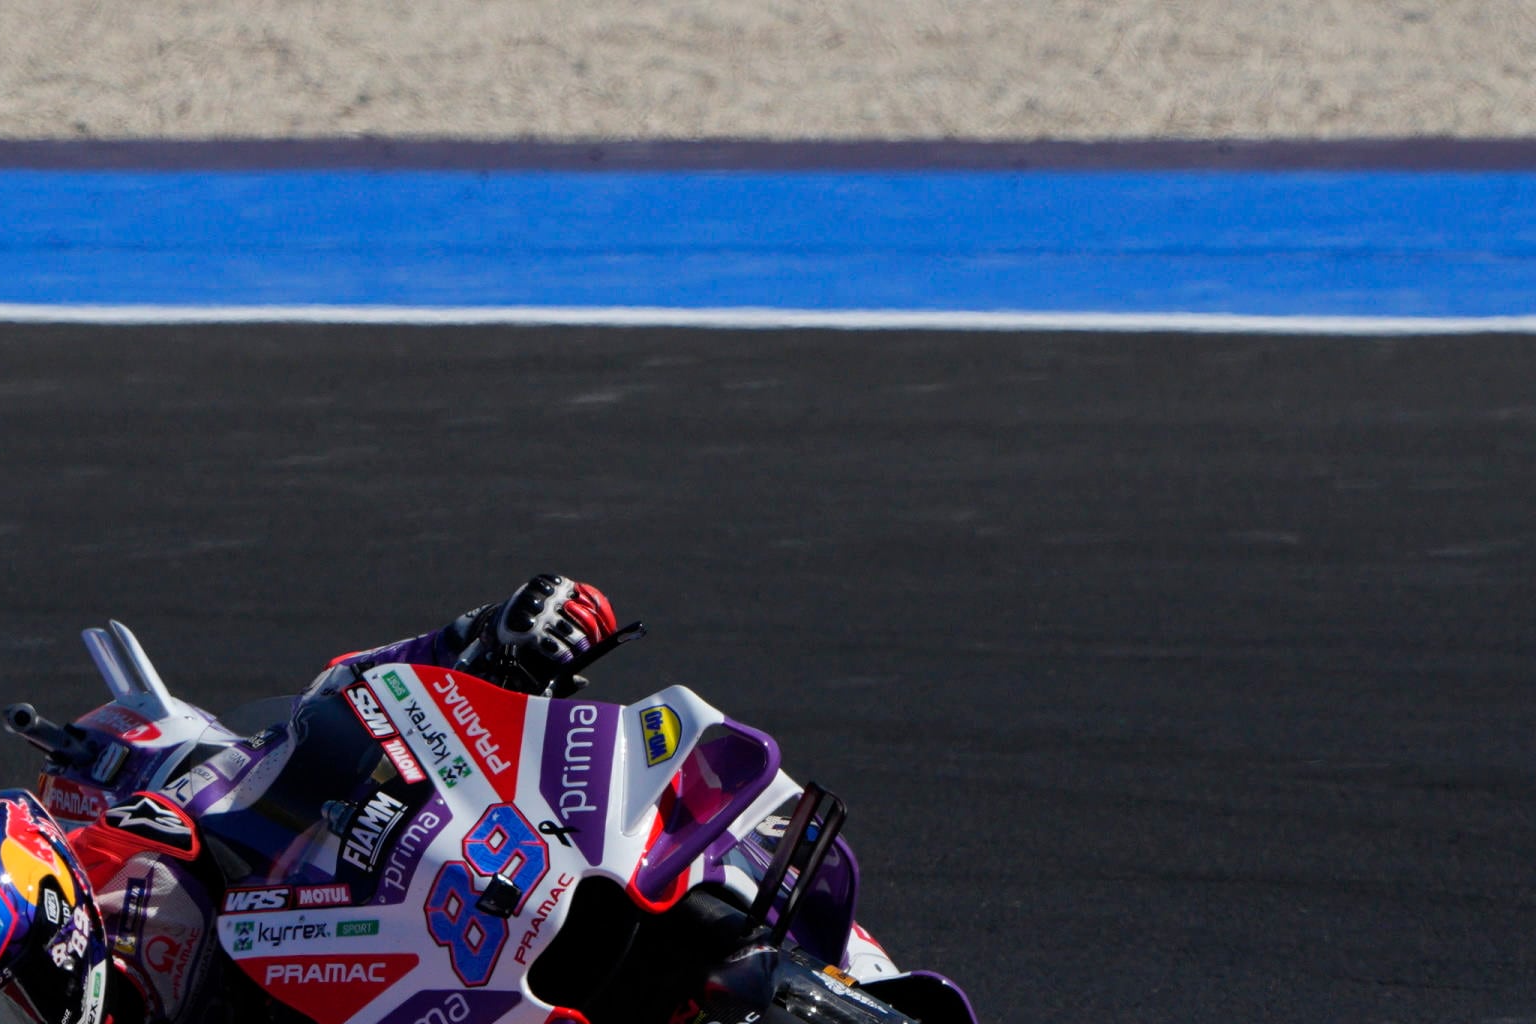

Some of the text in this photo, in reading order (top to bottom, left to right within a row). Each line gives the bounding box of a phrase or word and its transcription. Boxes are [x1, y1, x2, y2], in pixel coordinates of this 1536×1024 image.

[386, 740, 424, 783] MOTUL
[433, 673, 512, 775] PRAMAC
[559, 704, 598, 820] prima
[644, 709, 667, 760] WD-40
[342, 790, 405, 872] FIAMM
[384, 811, 441, 890] prima
[299, 886, 350, 905] MOTUL
[341, 922, 373, 935] SPORT
[424, 802, 550, 987] 89
[514, 873, 575, 965] PRAMAC
[265, 961, 387, 986] PRAMAC
